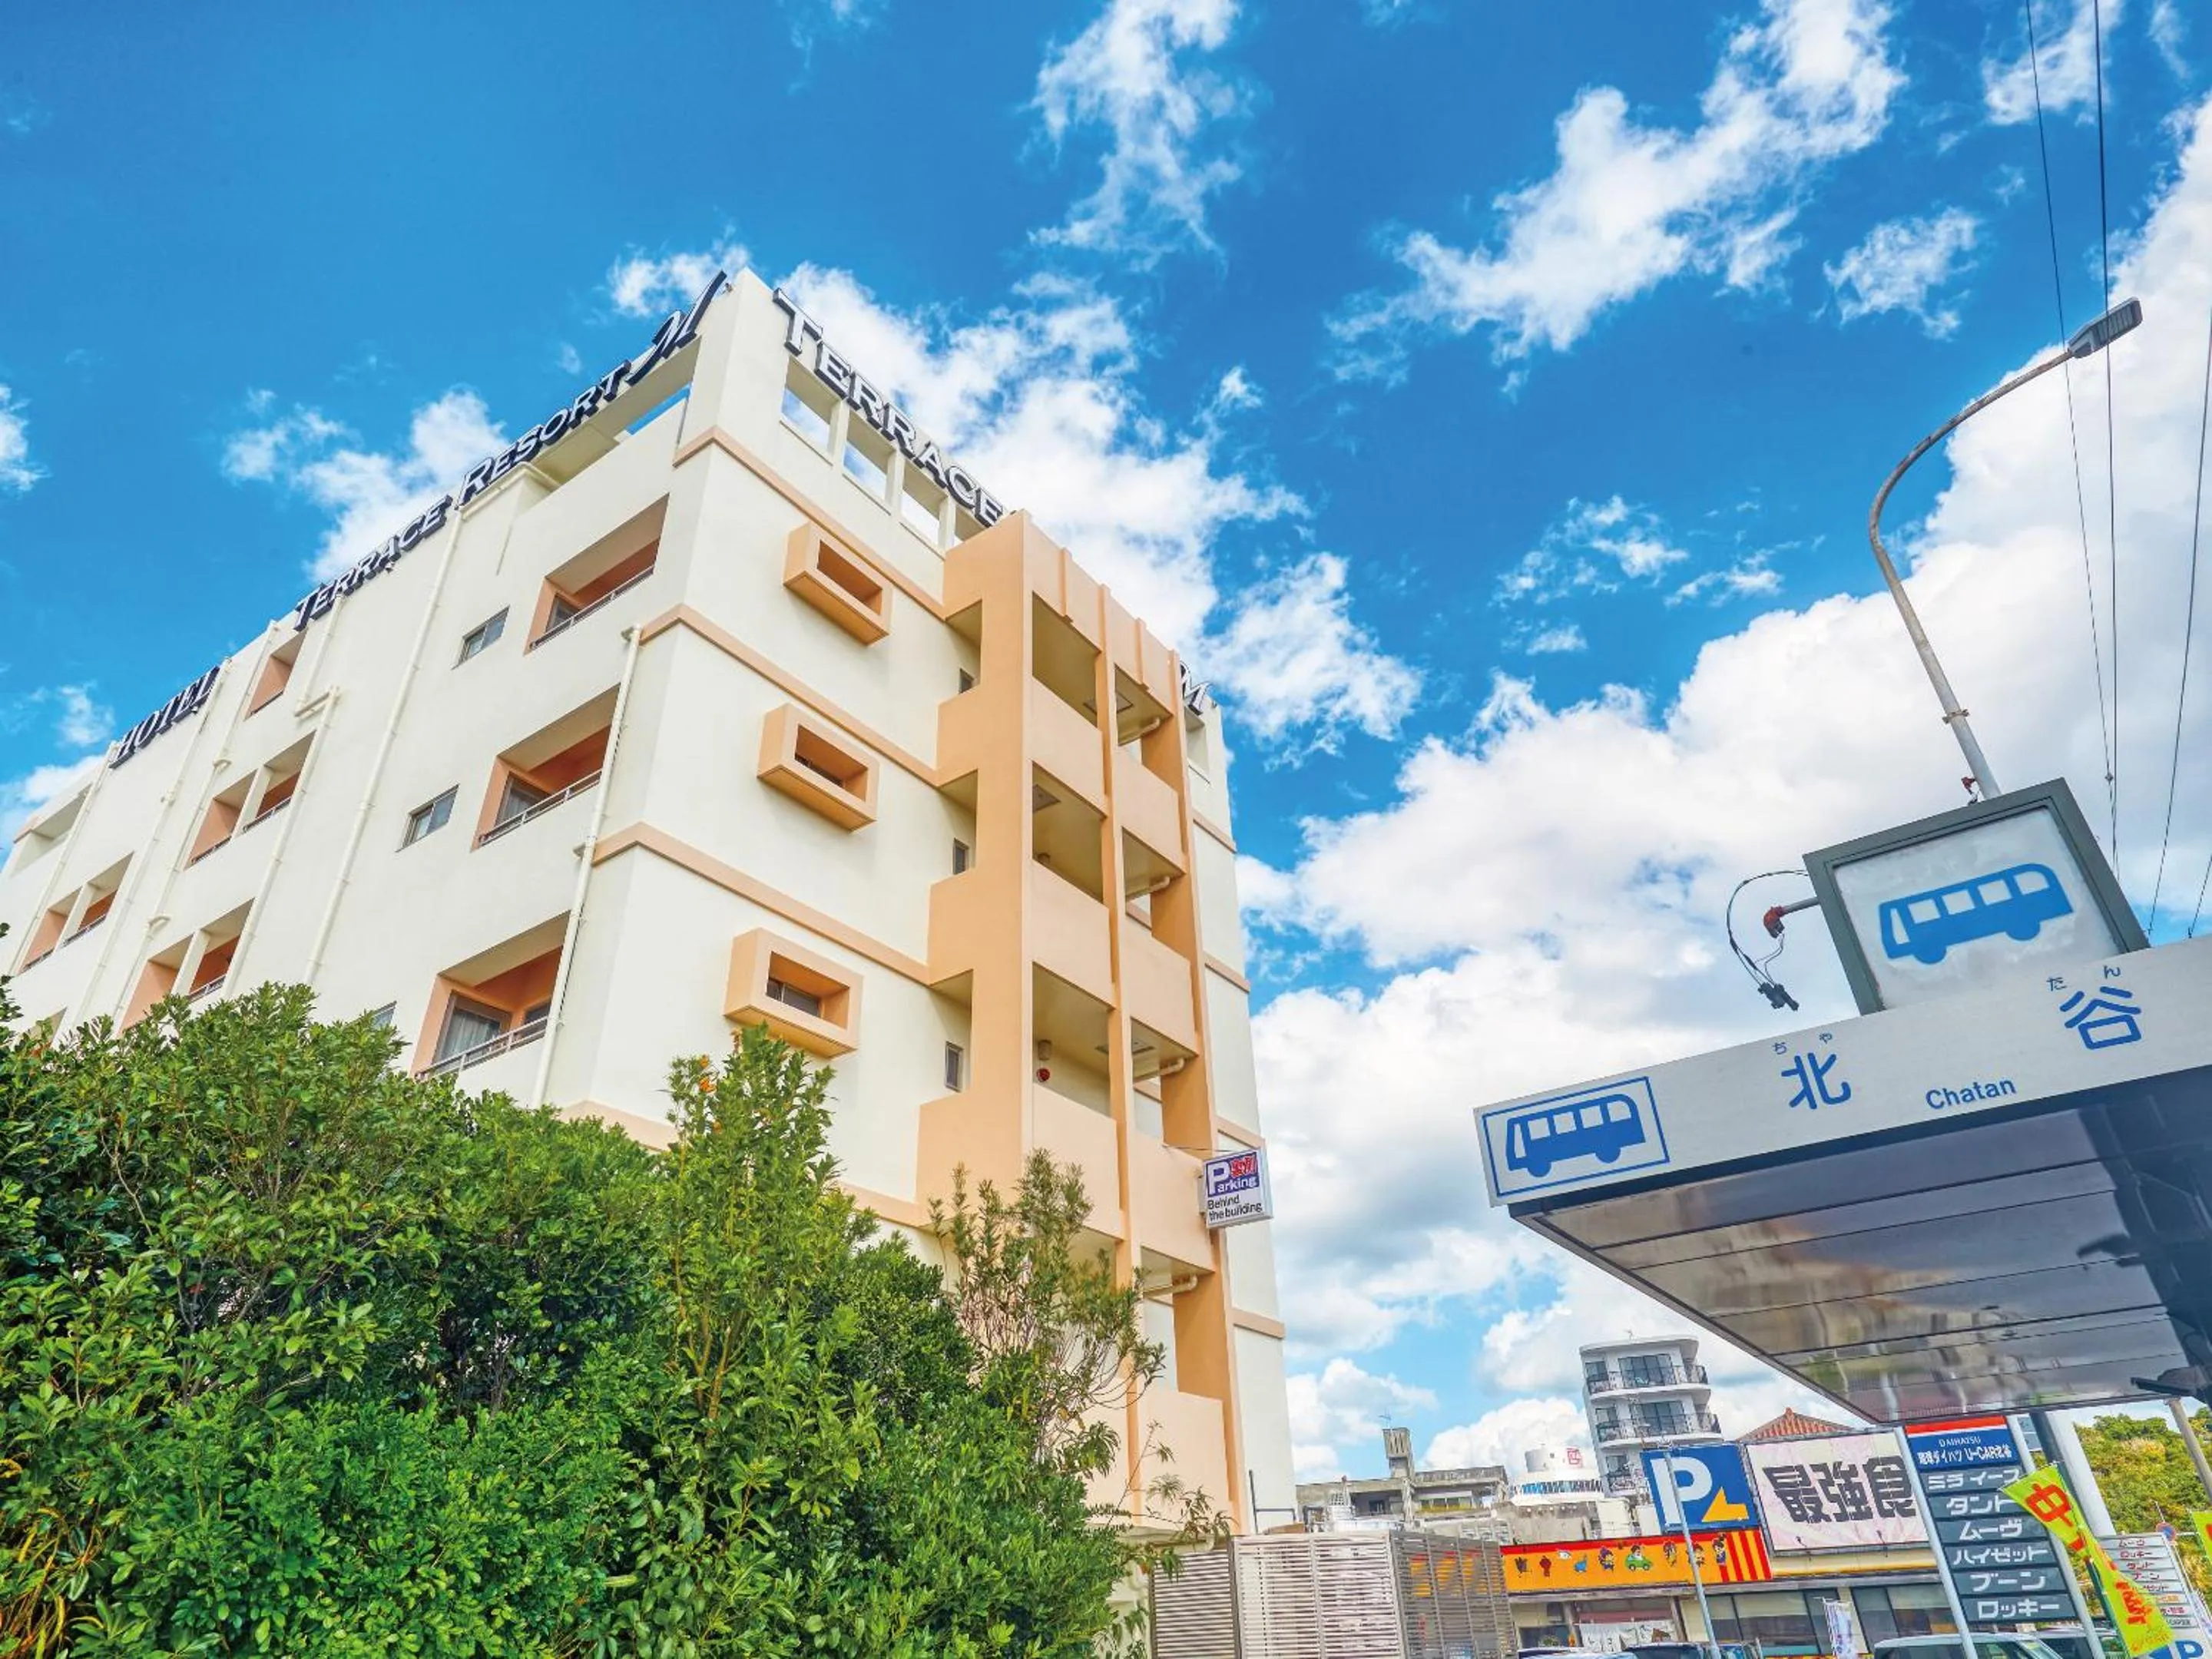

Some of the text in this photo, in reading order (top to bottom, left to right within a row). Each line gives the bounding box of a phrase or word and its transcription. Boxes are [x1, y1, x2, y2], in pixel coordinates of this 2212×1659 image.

[773, 287, 1003, 528] TERRACE
[293, 495, 453, 631] TERRACE
[457, 359, 631, 508] RESORT
[1926, 1078, 2017, 1110] Chatan
[1207, 1161, 1257, 1195] Parking
[1207, 1194, 1240, 1210] Behind
[1225, 1202, 1263, 1218] building
[1650, 1456, 1713, 1525] P
[1946, 1495, 2017, 1516] タント
[1959, 1518, 2022, 1541] ムーヴ
[1952, 1545, 2049, 1566] ハイゼット
[1970, 1571, 2046, 1592] ブーン
[1977, 1598, 2060, 1620] ロッキー
